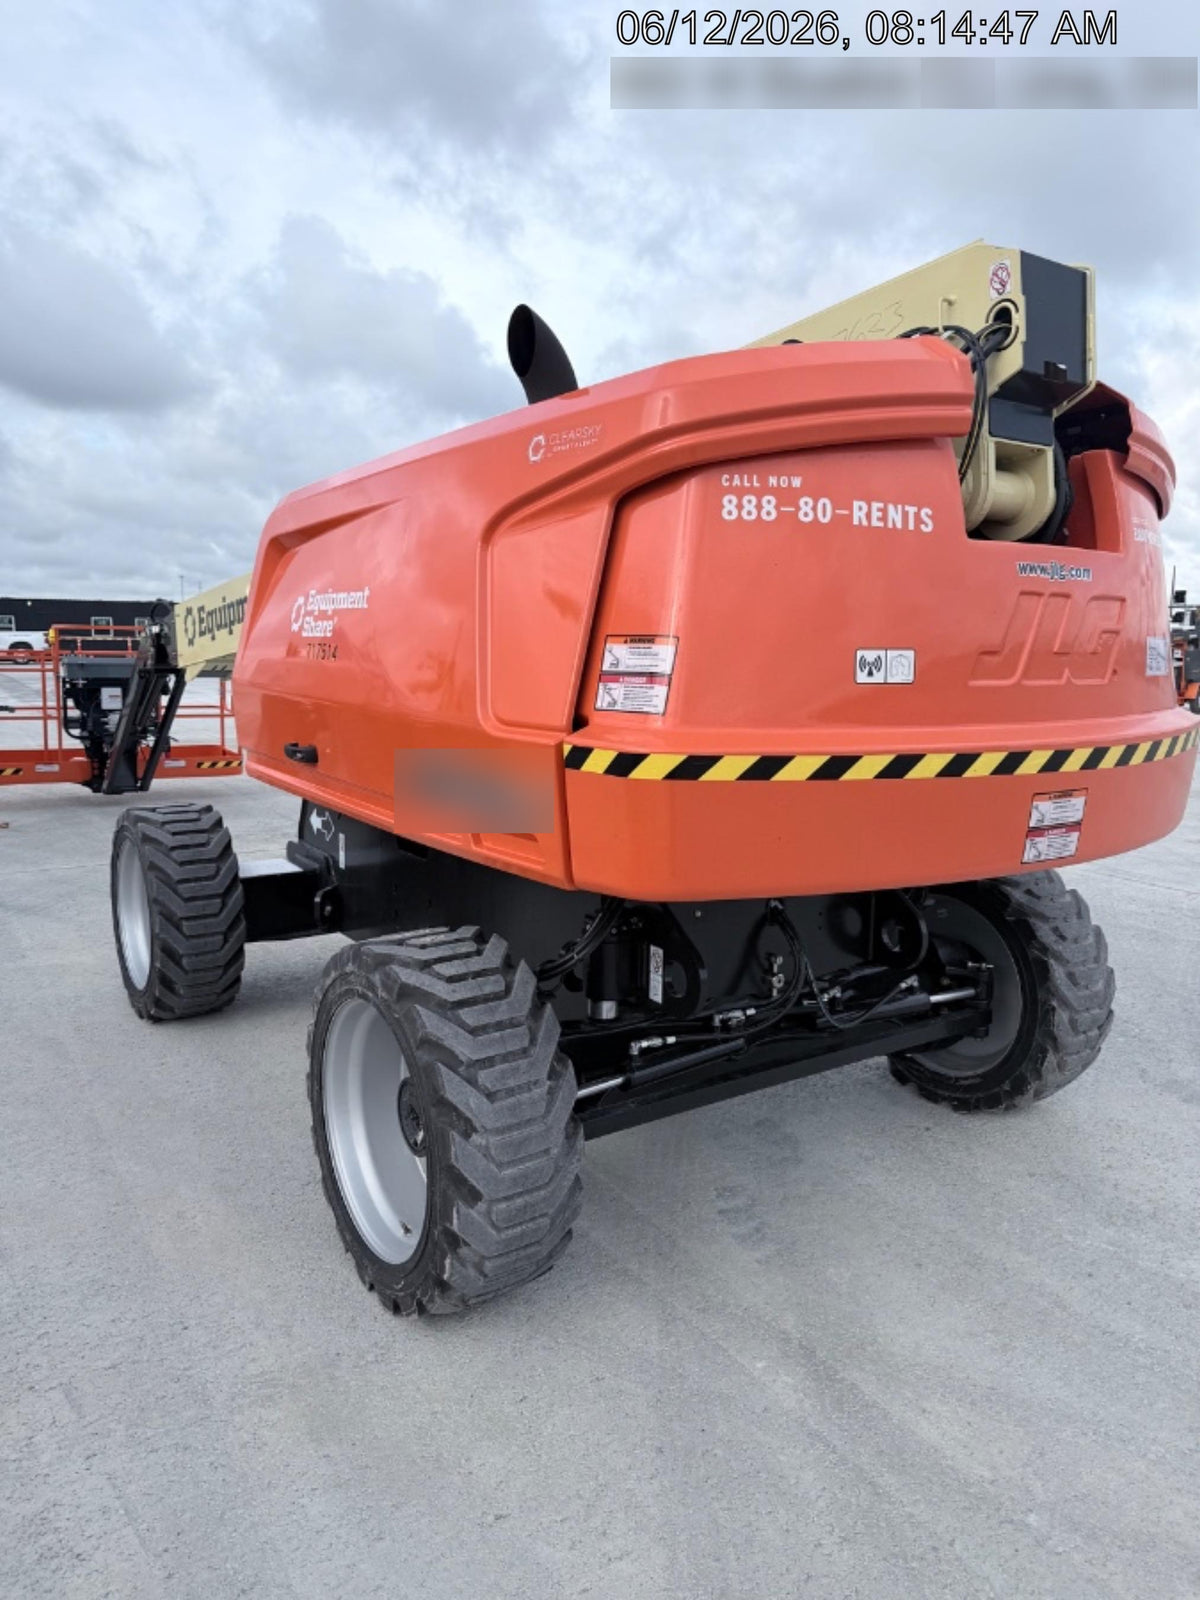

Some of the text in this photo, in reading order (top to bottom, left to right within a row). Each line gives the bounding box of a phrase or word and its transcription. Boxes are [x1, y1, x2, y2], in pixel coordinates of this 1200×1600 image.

[721, 474, 802, 488] CALL NOW
[721, 494, 934, 533] 888-80-RENTS
[1018, 561, 1091, 580] www.jlg.com
[306, 586, 370, 615] Equipment
[302, 615, 335, 637] Share
[968, 590, 1126, 686] JLG
